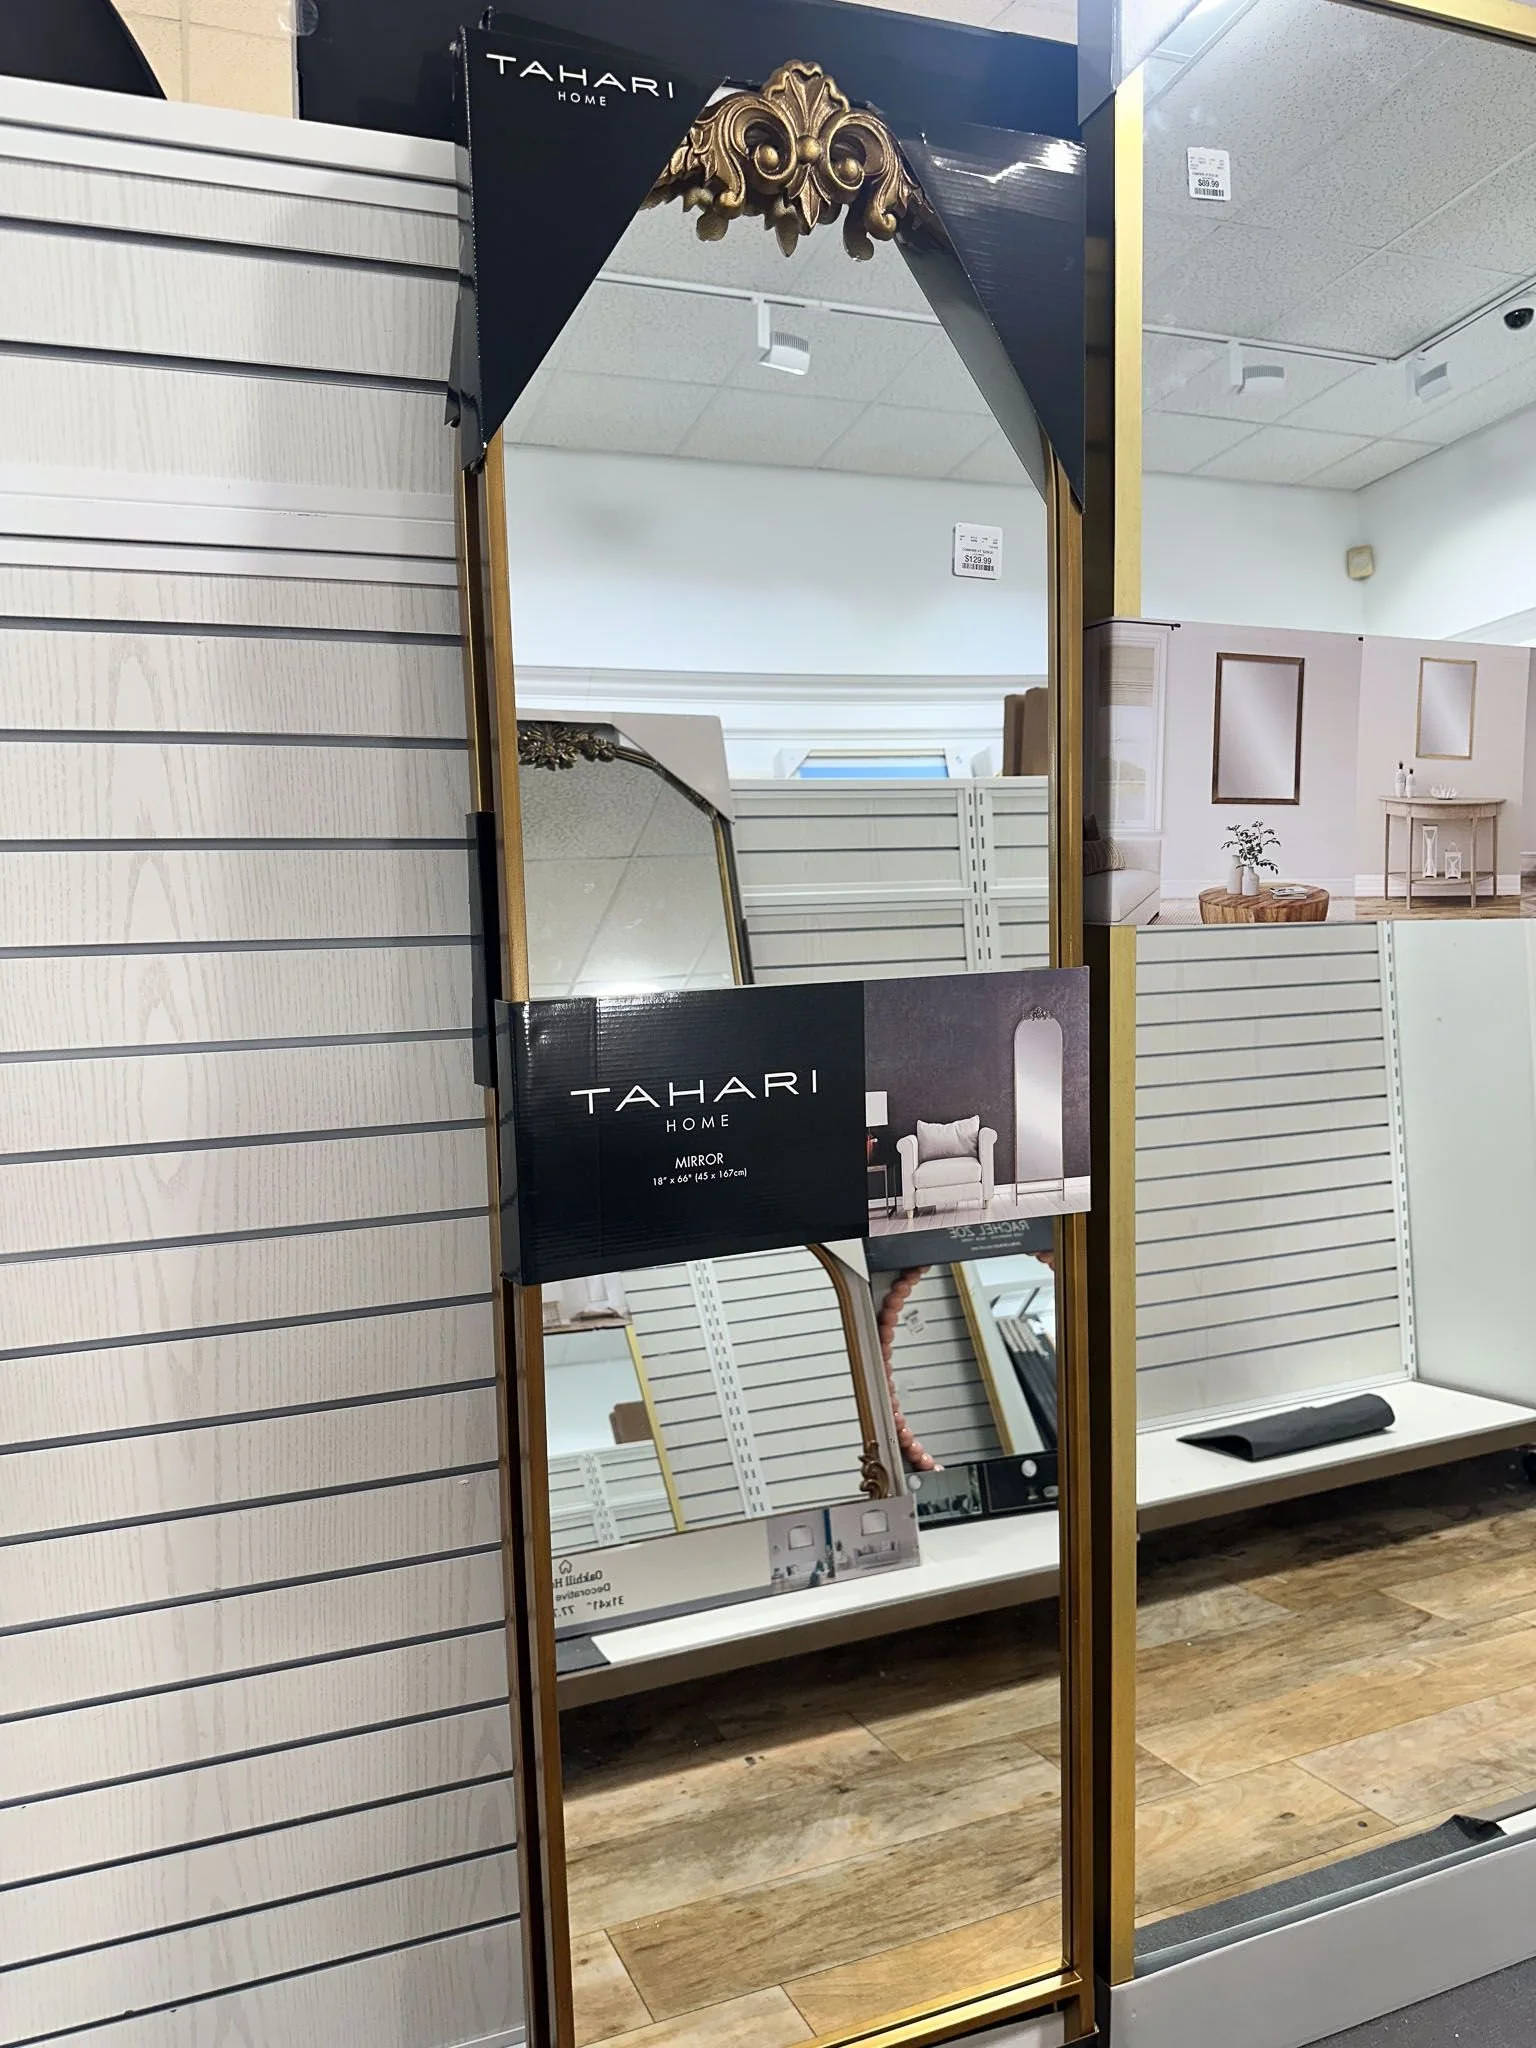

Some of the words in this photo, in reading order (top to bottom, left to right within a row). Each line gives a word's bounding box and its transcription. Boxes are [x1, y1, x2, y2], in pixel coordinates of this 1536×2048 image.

[486, 53, 674, 99] TAHARI
[558, 91, 607, 106] HOME
[964, 555, 992, 564] $129.99
[570, 1069, 817, 1114] TAHARI
[666, 1114, 730, 1133] HOME
[675, 1152, 724, 1169] MIRROR
[695, 1171, 709, 1183] (45
[719, 1168, 747, 1178] 167cm)
